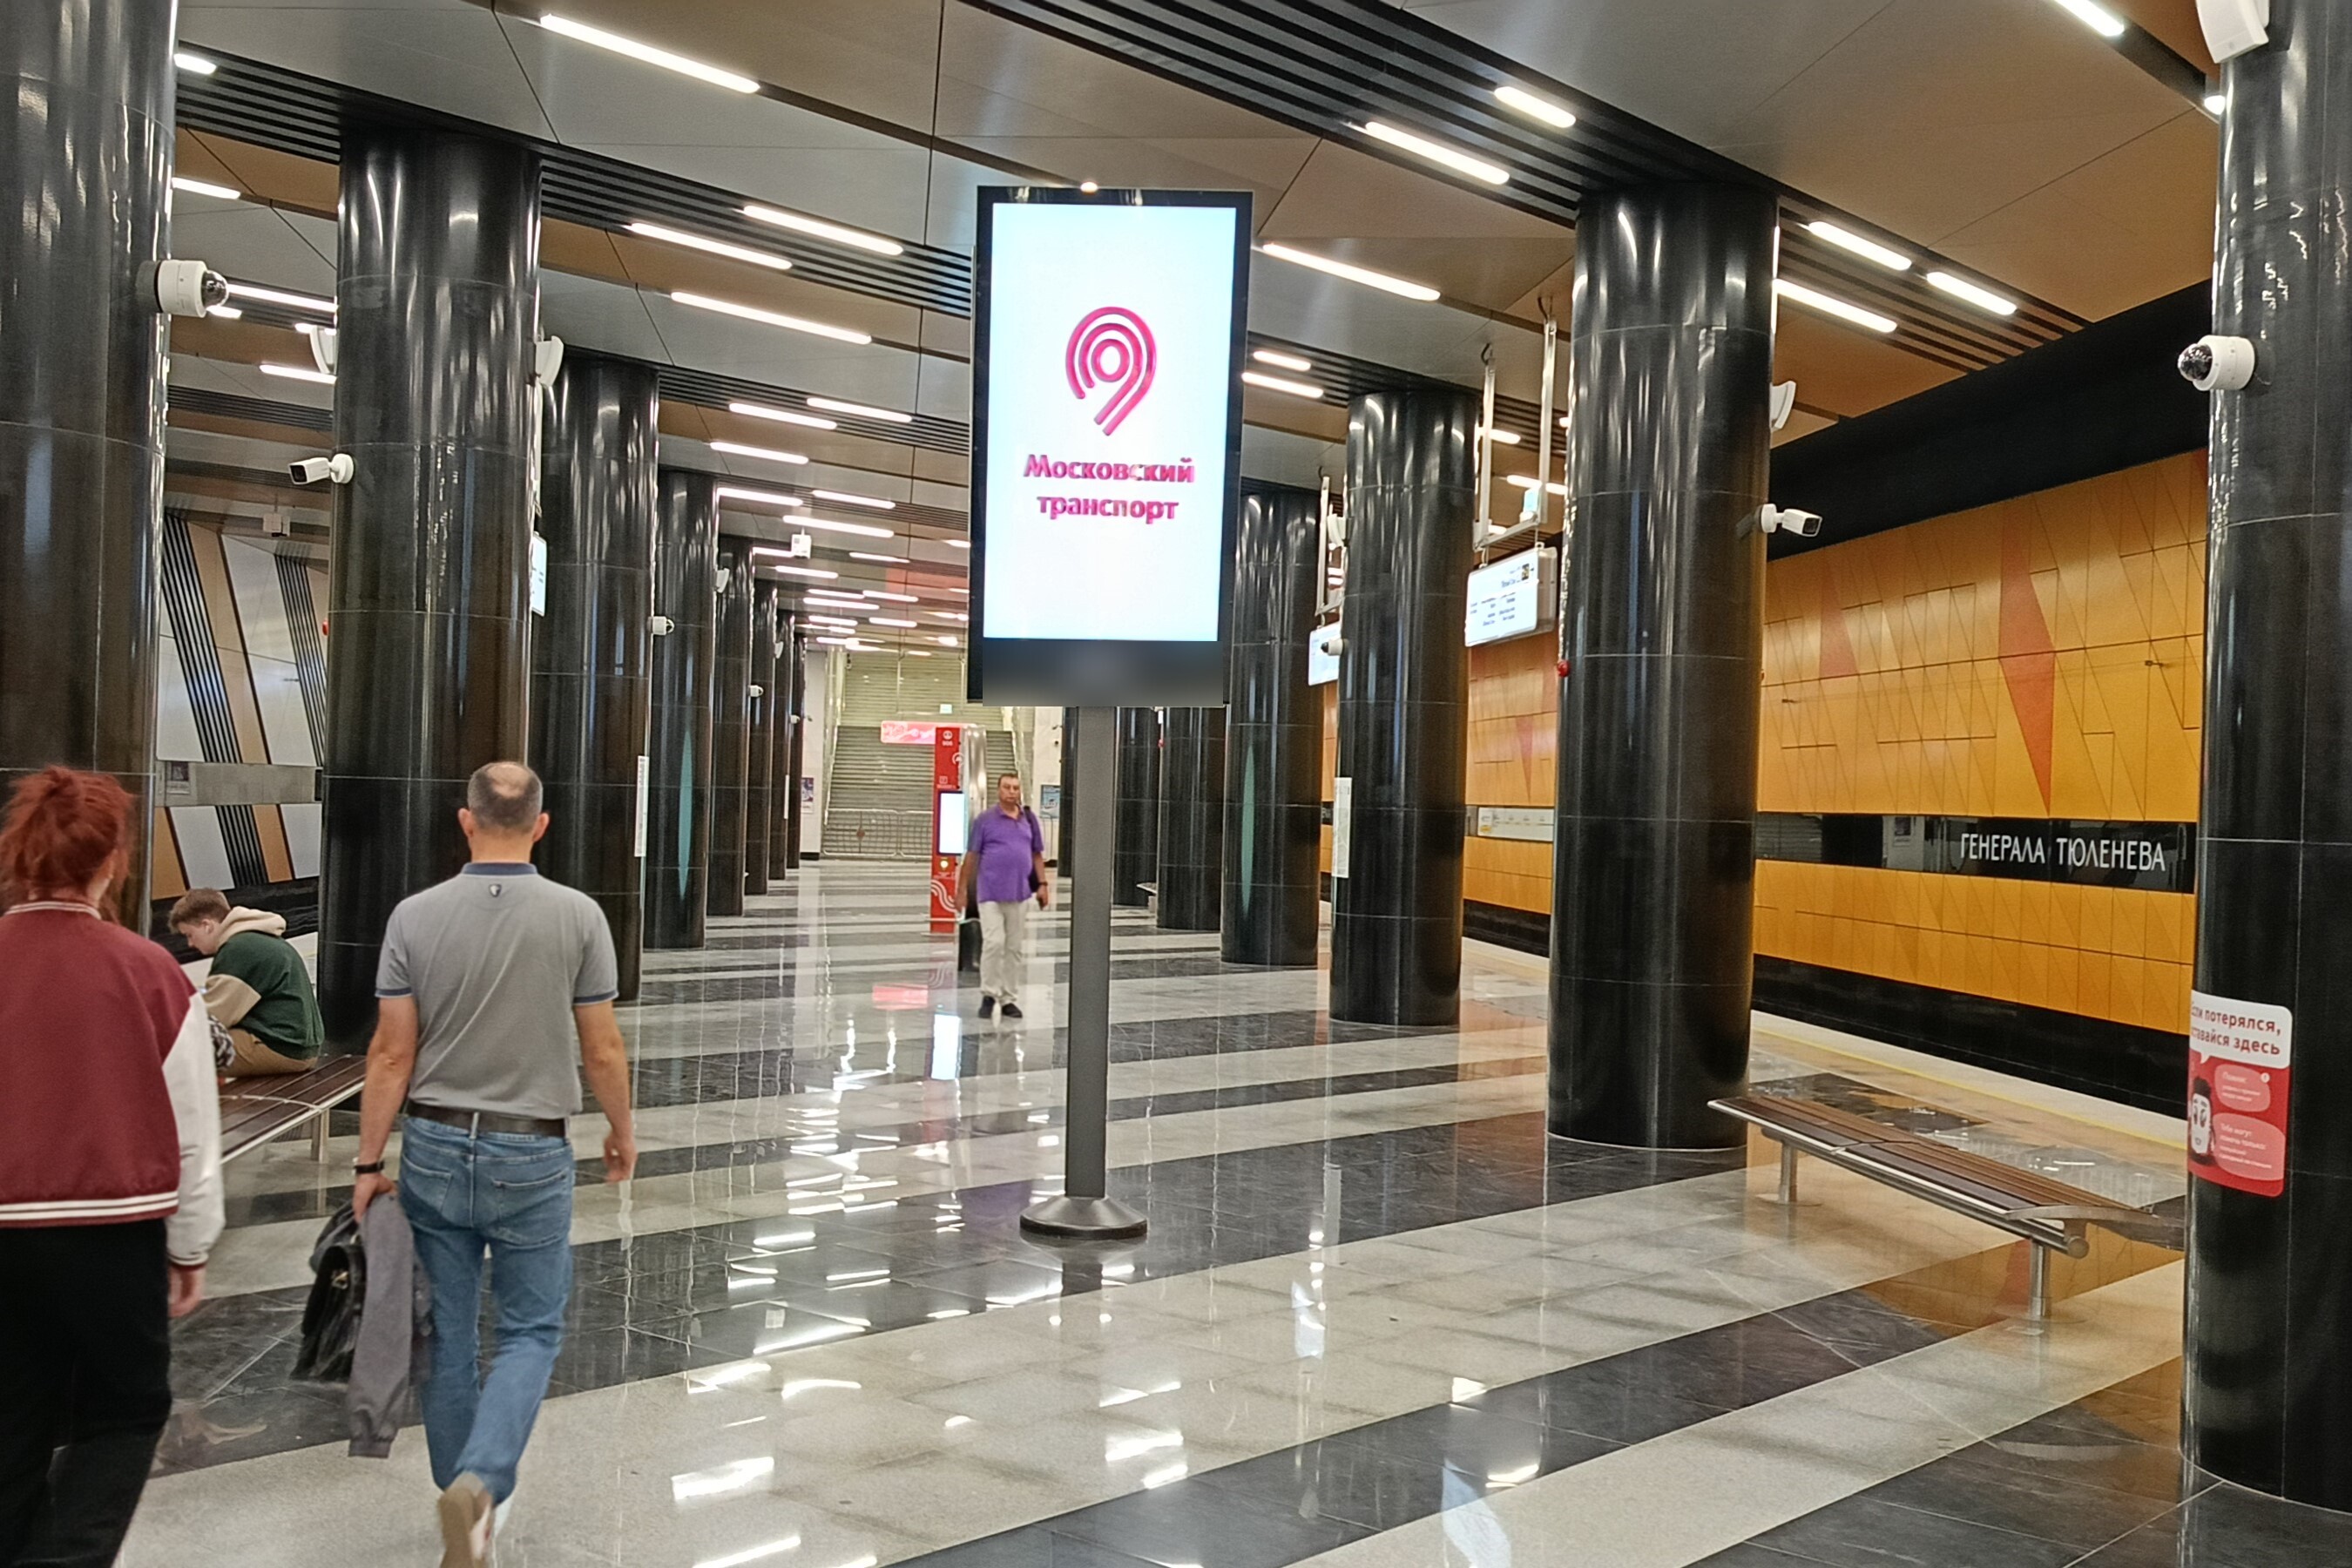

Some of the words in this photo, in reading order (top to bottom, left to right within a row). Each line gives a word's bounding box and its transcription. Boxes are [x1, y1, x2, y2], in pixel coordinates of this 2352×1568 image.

[1023, 454, 1194, 483] Московский
[1037, 496, 1179, 524] транспорт
[1960, 833, 2045, 864] ГЕНЕРАЛА
[2056, 837, 2166, 872] ТЮЛЕНЕВА
[2205, 1010, 2281, 1037] потерялся,
[2191, 1026, 2230, 1046] ставайся
[2234, 1037, 2281, 1056] здесь
